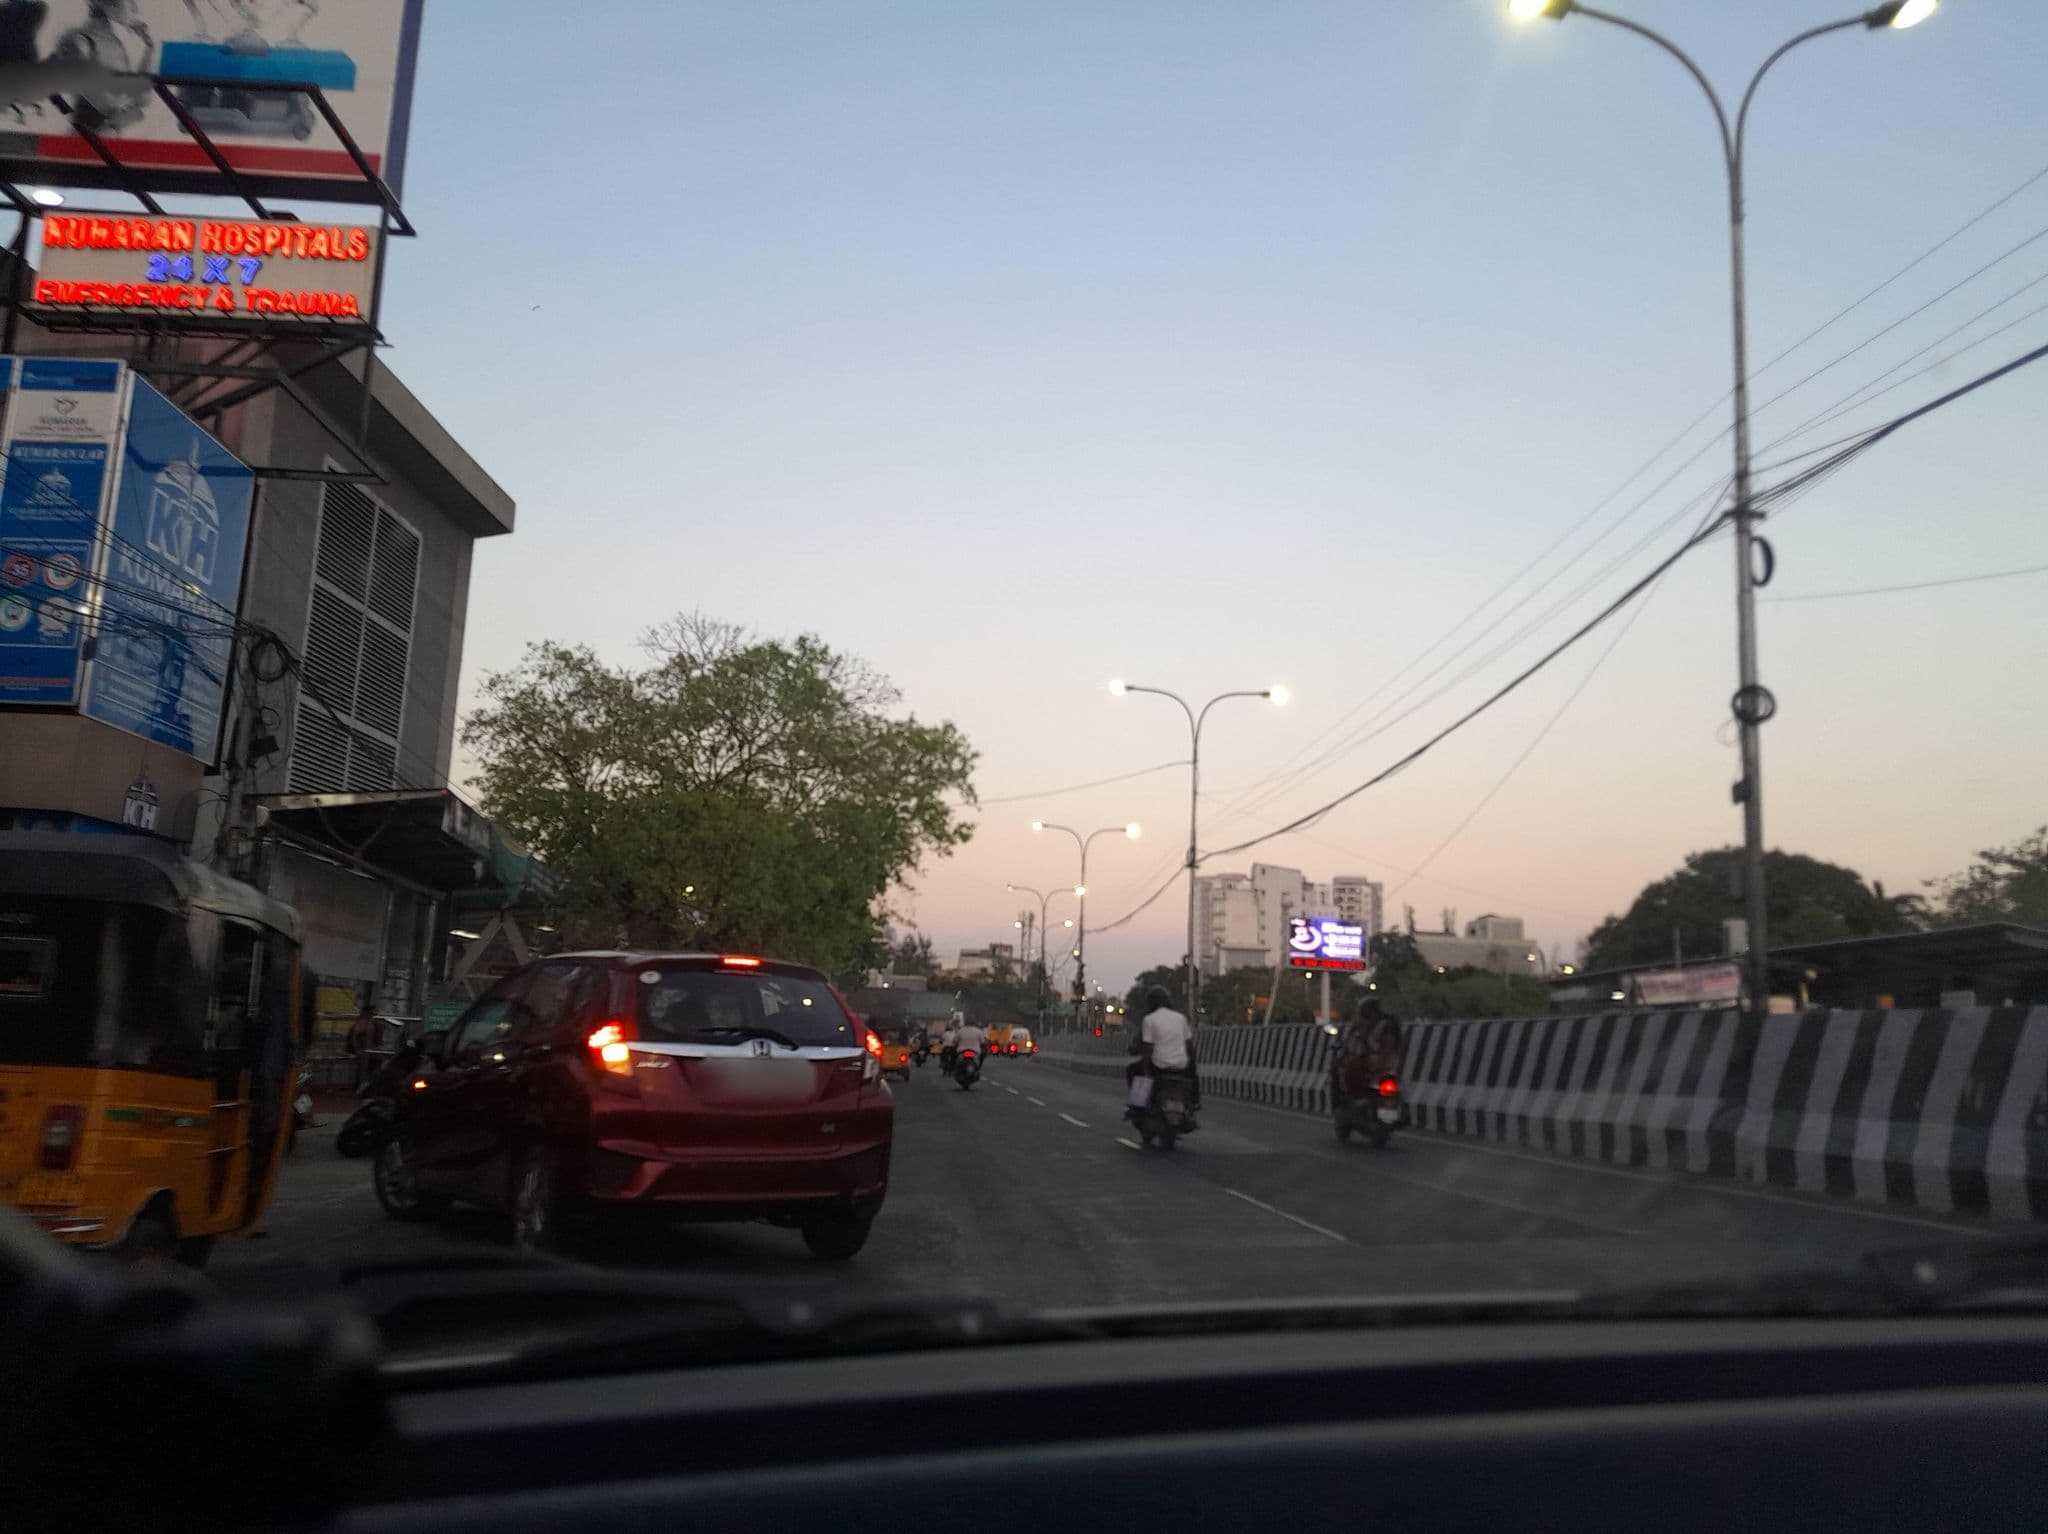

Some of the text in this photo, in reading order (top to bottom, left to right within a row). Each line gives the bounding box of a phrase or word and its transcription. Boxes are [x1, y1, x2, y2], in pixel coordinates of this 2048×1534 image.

[44, 215, 369, 262] KUMARAN HOSPITALS
[146, 253, 194, 283] 24
[238, 257, 263, 285] 7
[34, 279, 360, 318] EMERGENCY & TRAUMA
